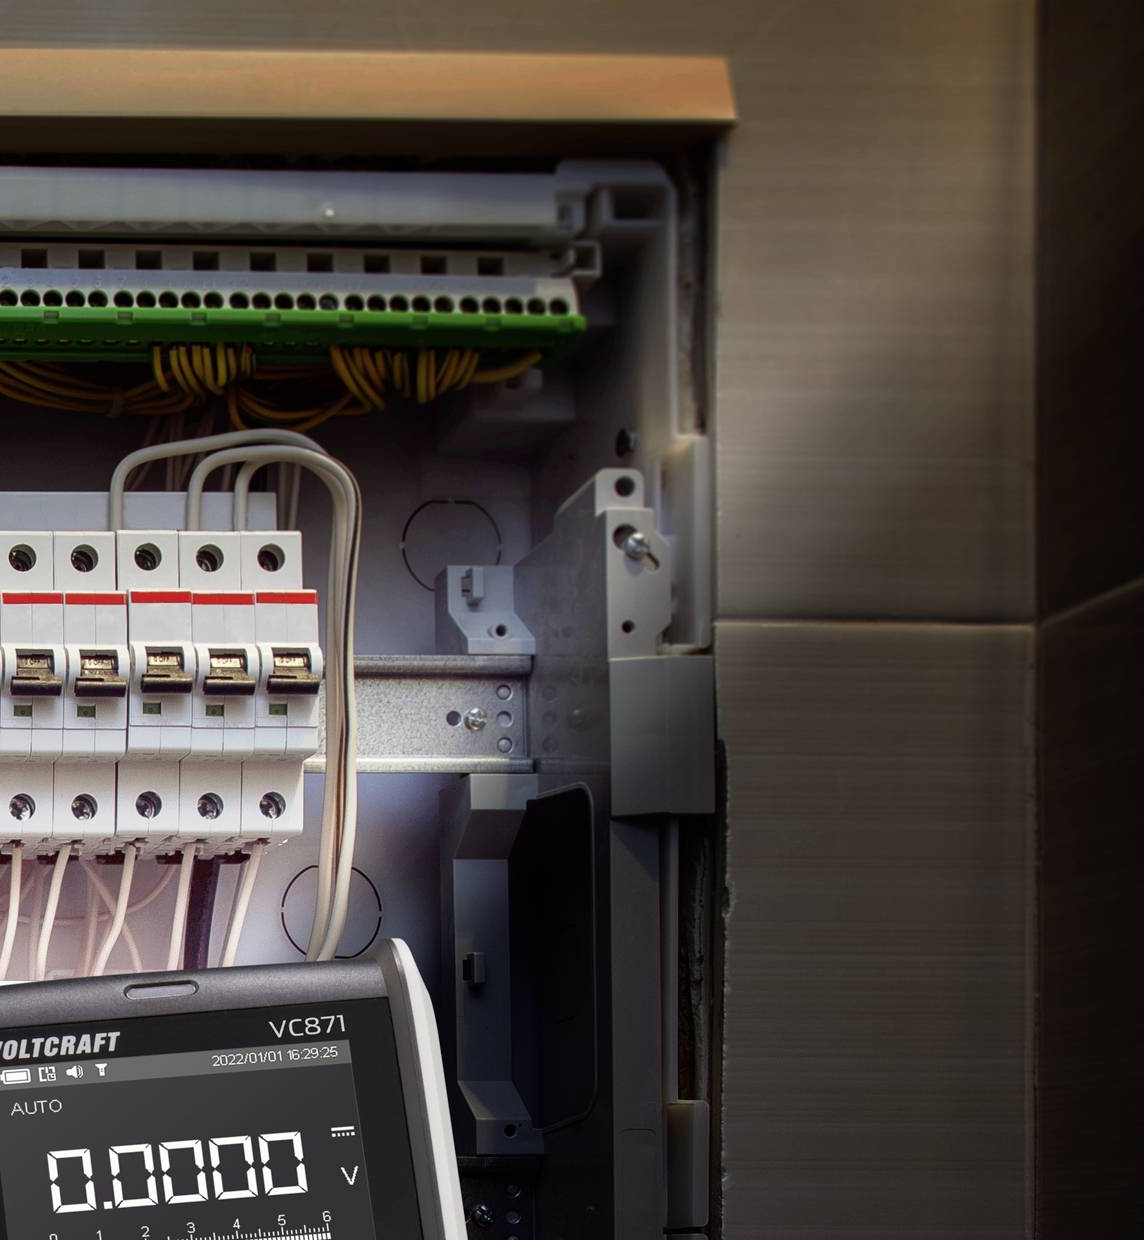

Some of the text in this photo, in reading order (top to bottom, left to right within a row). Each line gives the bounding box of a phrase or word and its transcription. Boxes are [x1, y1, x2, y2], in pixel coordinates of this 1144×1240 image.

[268, 1014, 345, 1038] VC871
[211, 1046, 338, 1067] 2022/01/01 16:29:25
[10, 1099, 63, 1116] AUTO
[46, 1131, 308, 1213] 0.0000
[340, 1166, 359, 1186] V
[96, 1230, 102, 1240] 1
[140, 1226, 150, 1238] 2
[186, 1222, 196, 1234] 3
[232, 1218, 241, 1230] 4
[277, 1214, 287, 1226] 5
[322, 1211, 332, 1222] 6
